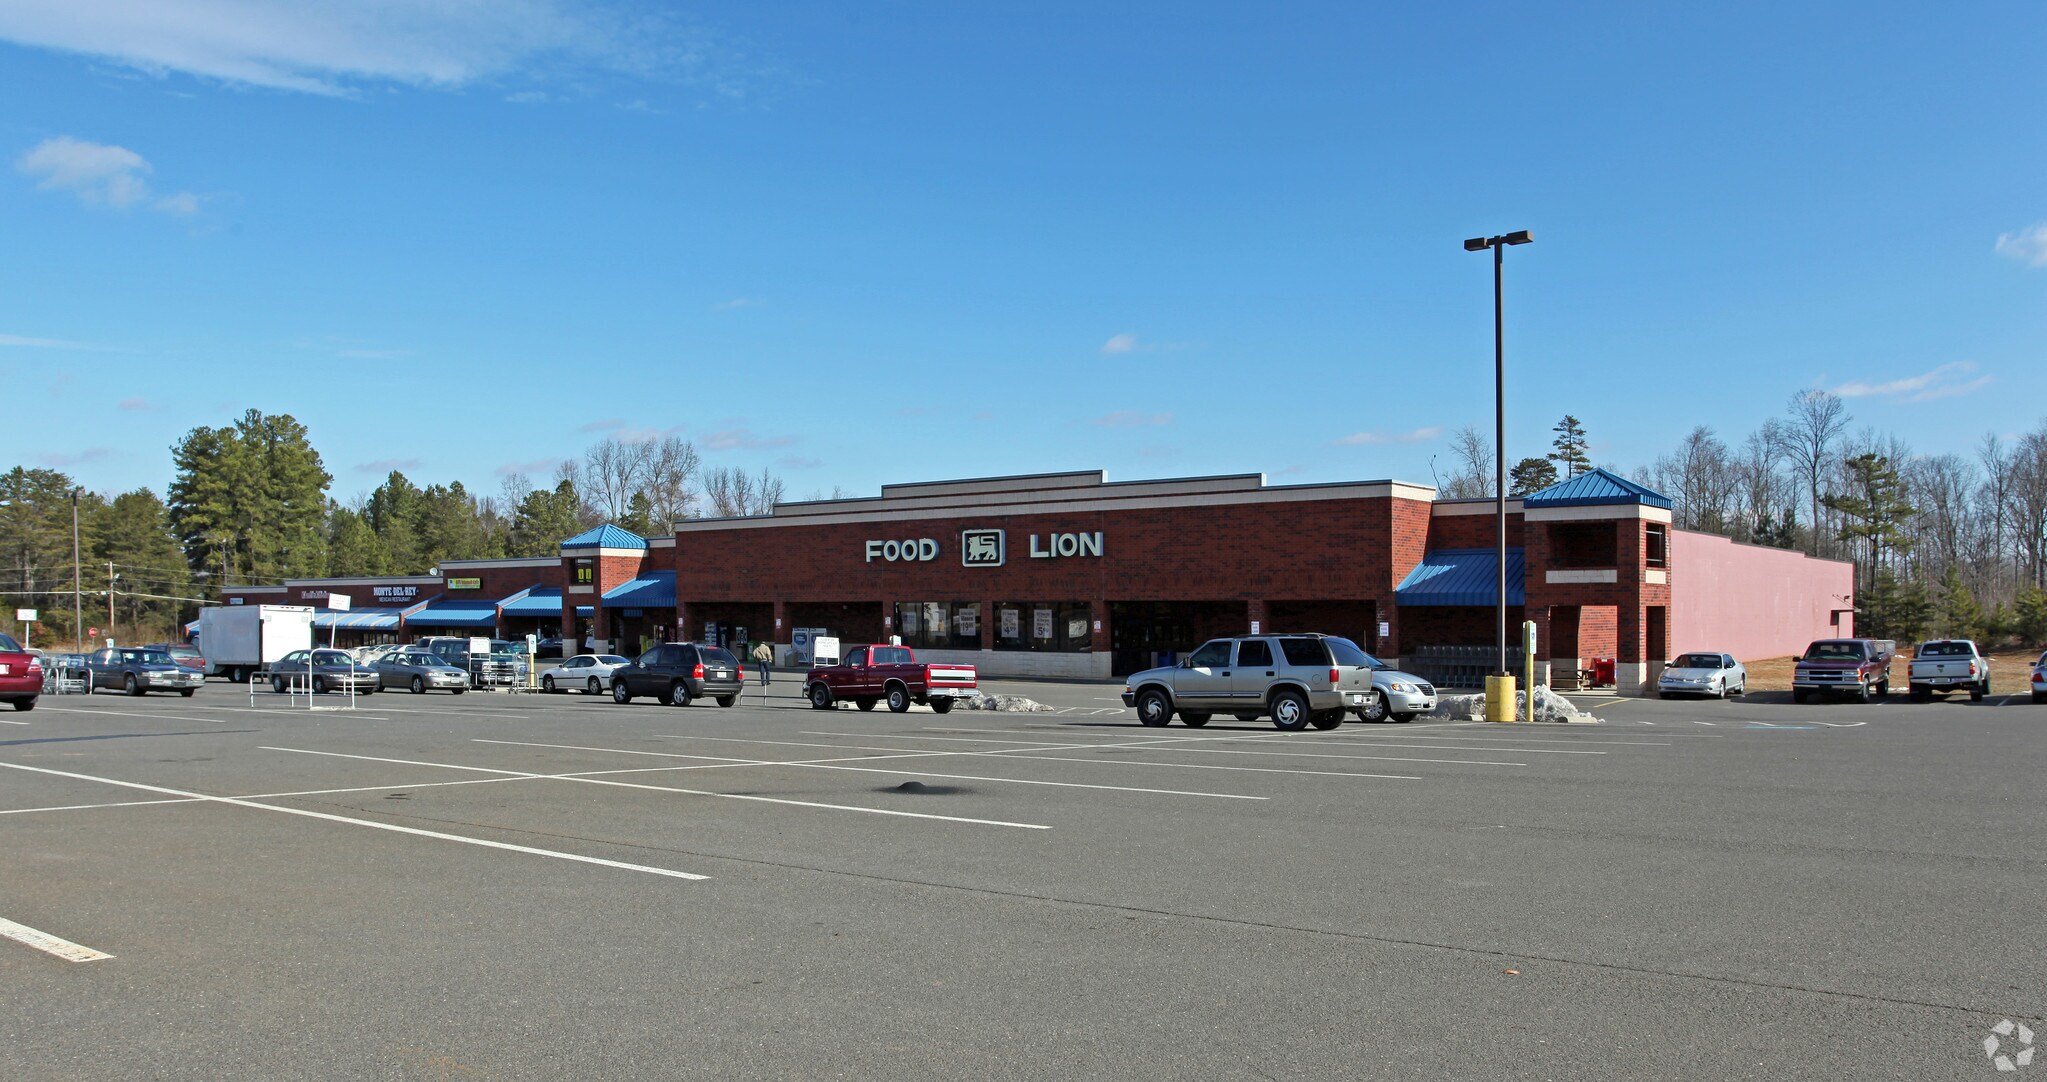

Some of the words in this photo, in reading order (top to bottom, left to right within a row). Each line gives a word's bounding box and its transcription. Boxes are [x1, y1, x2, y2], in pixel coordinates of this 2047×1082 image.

[866, 538, 940, 562] FOOD
[1030, 532, 1104, 558] LION
[373, 586, 392, 597] MONTE
[404, 586, 417, 597] REY
